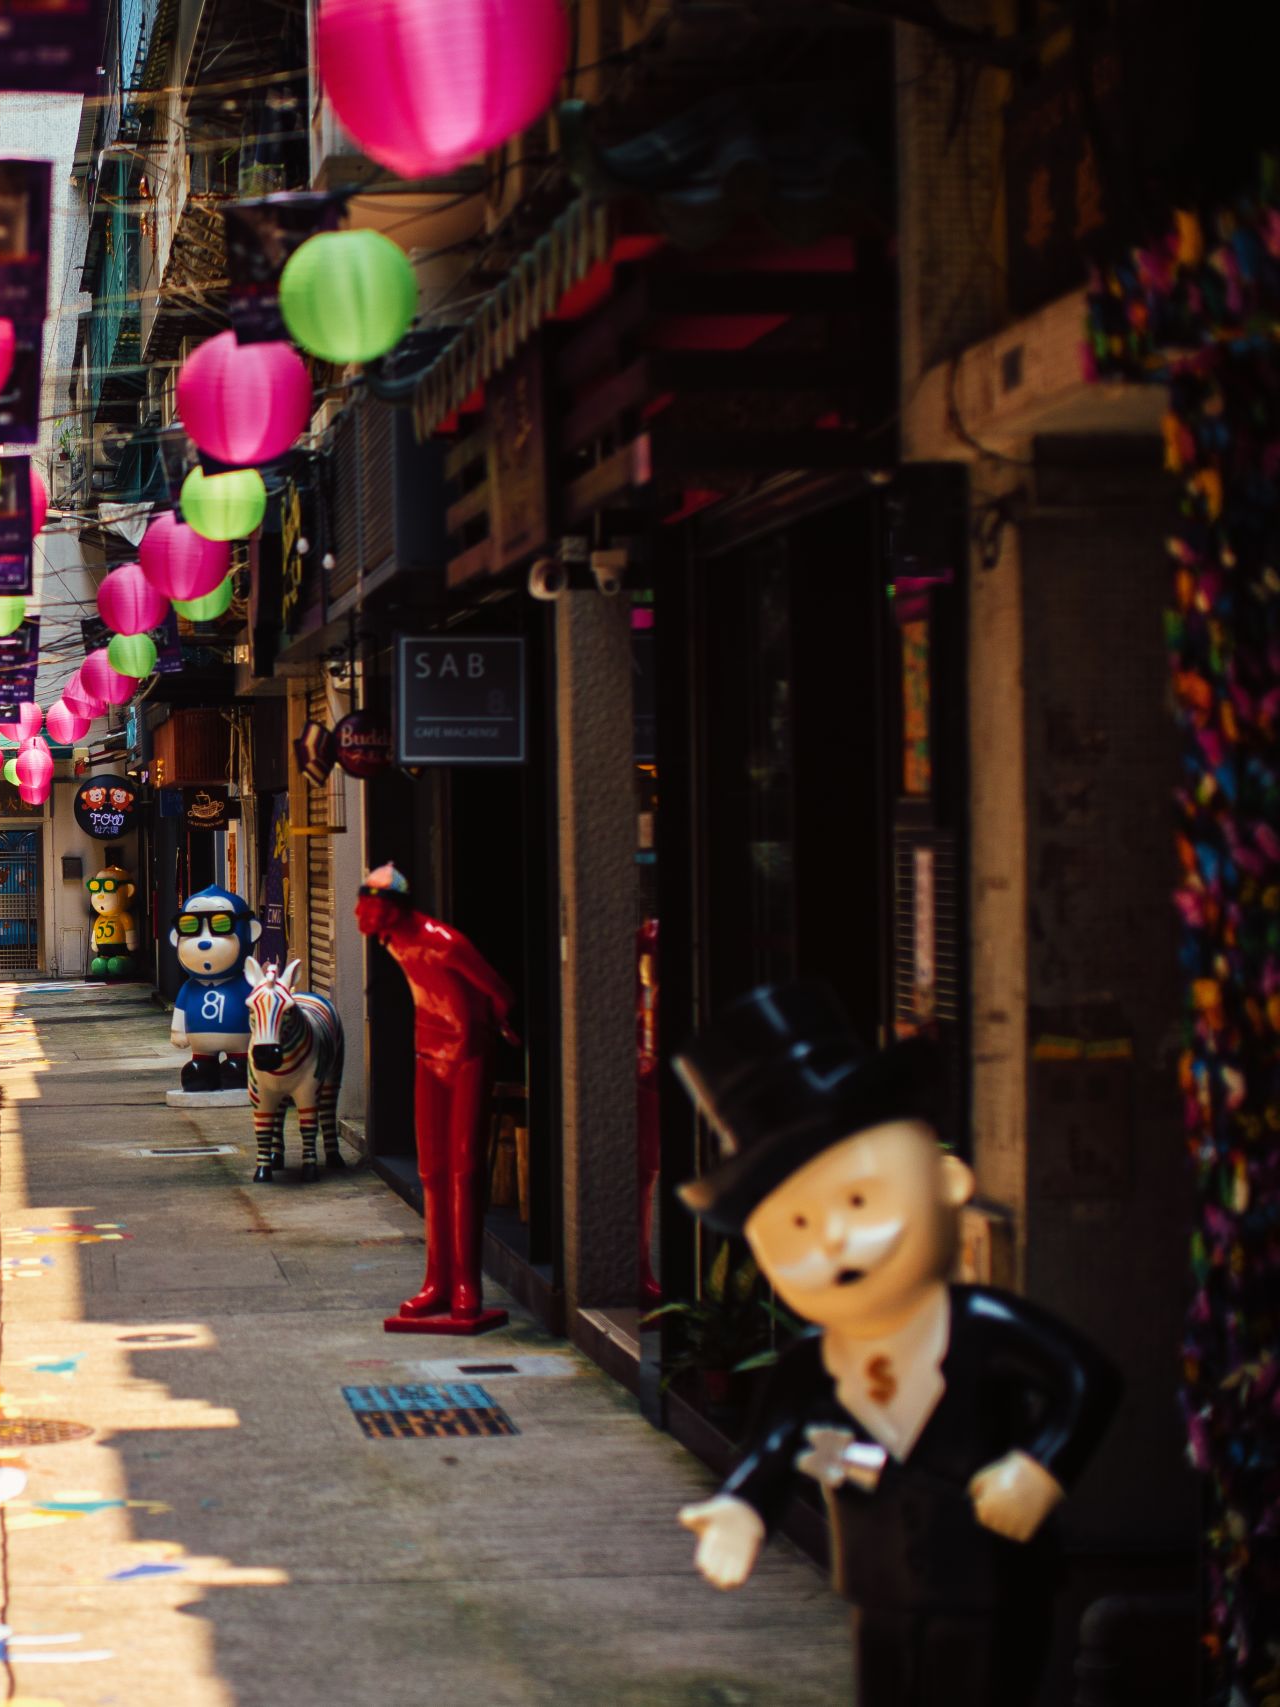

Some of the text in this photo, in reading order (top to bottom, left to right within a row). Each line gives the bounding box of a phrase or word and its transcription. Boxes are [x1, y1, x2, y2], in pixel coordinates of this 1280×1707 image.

[414, 652, 487, 679] SAB
[96, 920, 116, 939] 55
[201, 990, 225, 1024] 81
